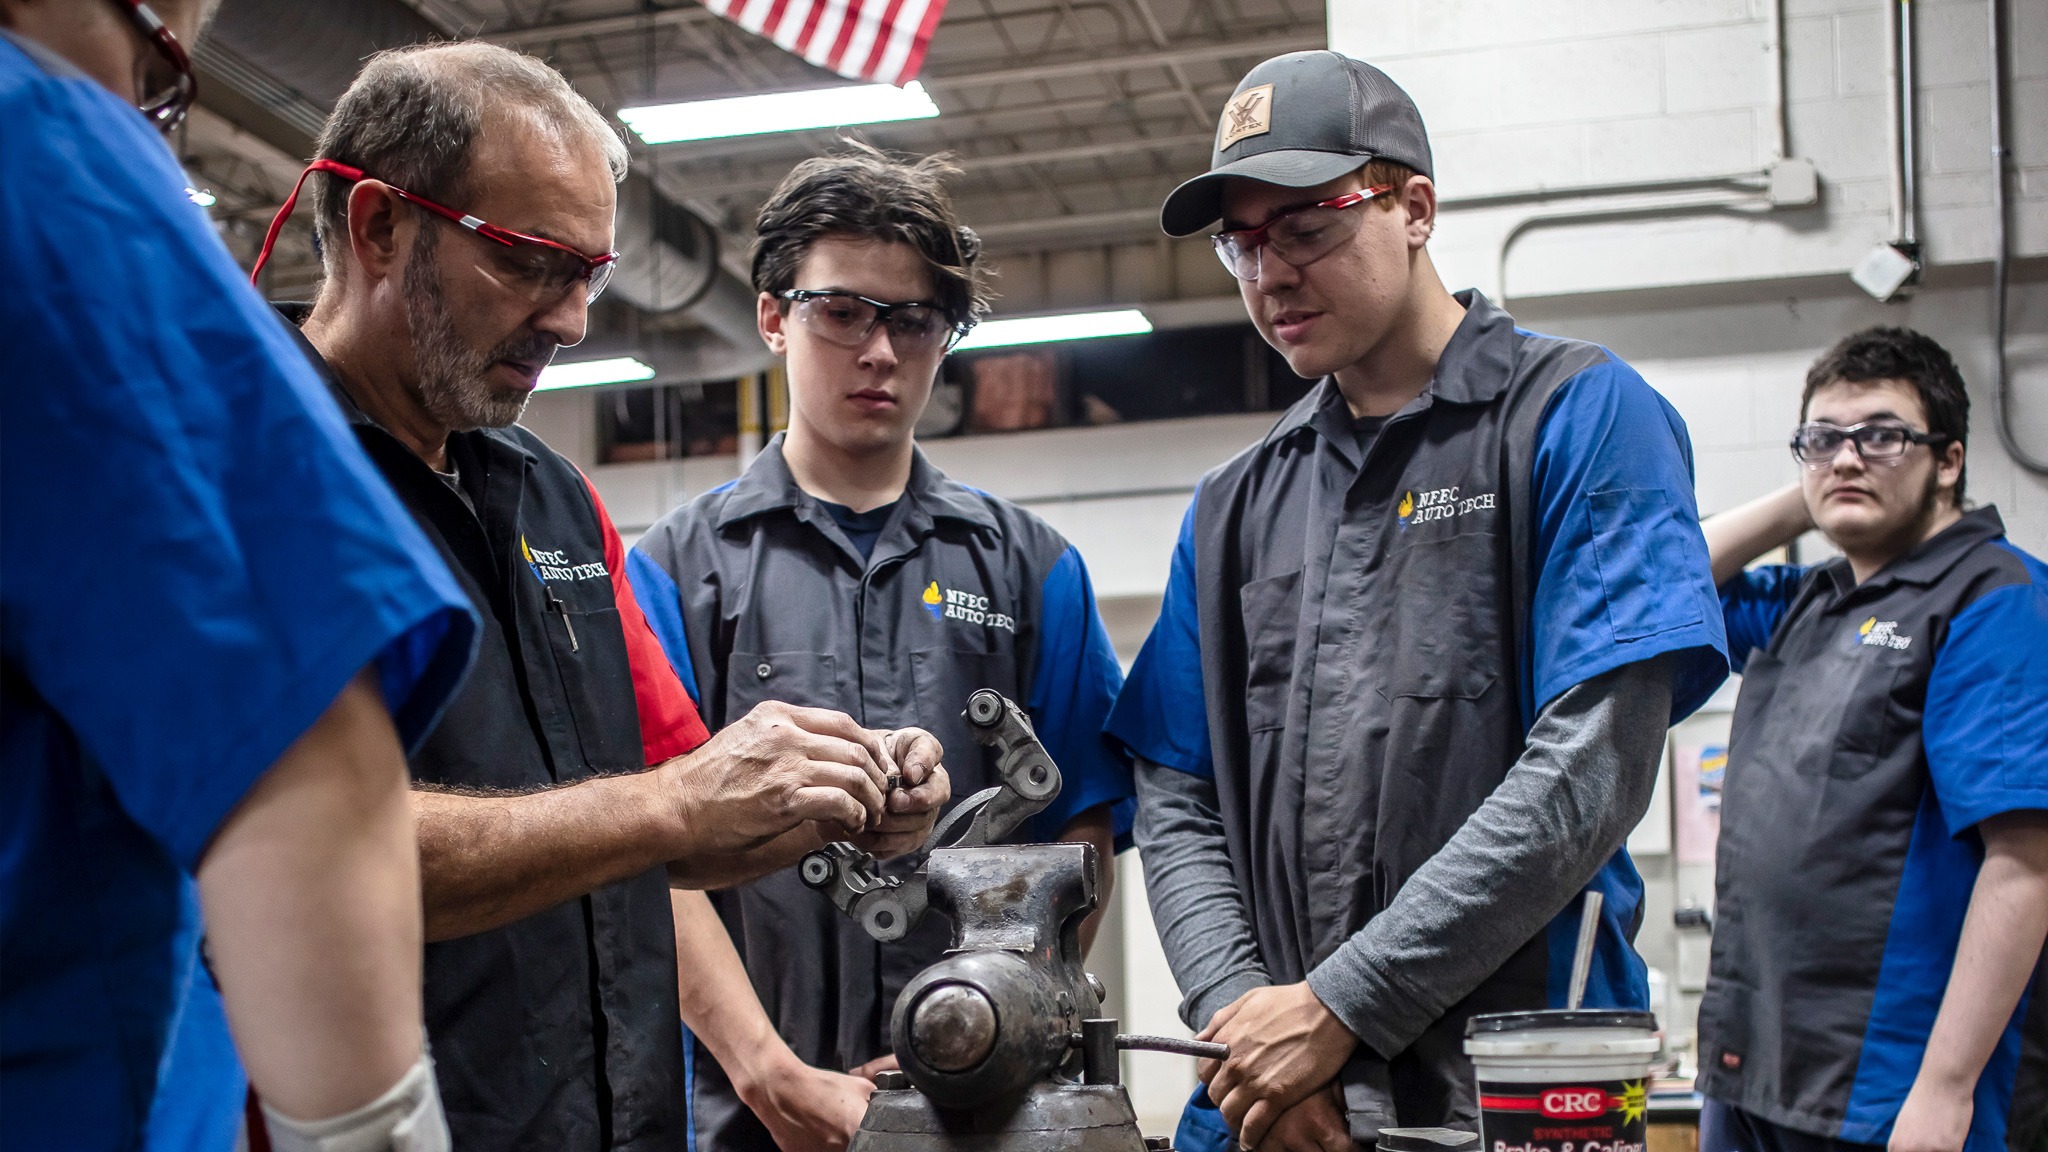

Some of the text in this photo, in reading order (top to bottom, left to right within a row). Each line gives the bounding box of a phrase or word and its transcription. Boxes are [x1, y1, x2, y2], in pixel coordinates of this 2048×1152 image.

[1225, 121, 1262, 140] ORTEX
[1416, 486, 1459, 508] NFEC
[1411, 493, 1496, 525] AUTO TECH
[529, 547, 569, 566] NFEC
[540, 562, 609, 581] AUTO TECH
[945, 588, 989, 611] NFEC
[945, 604, 985, 624] AUTO
[1543, 1091, 1601, 1113] CRC
